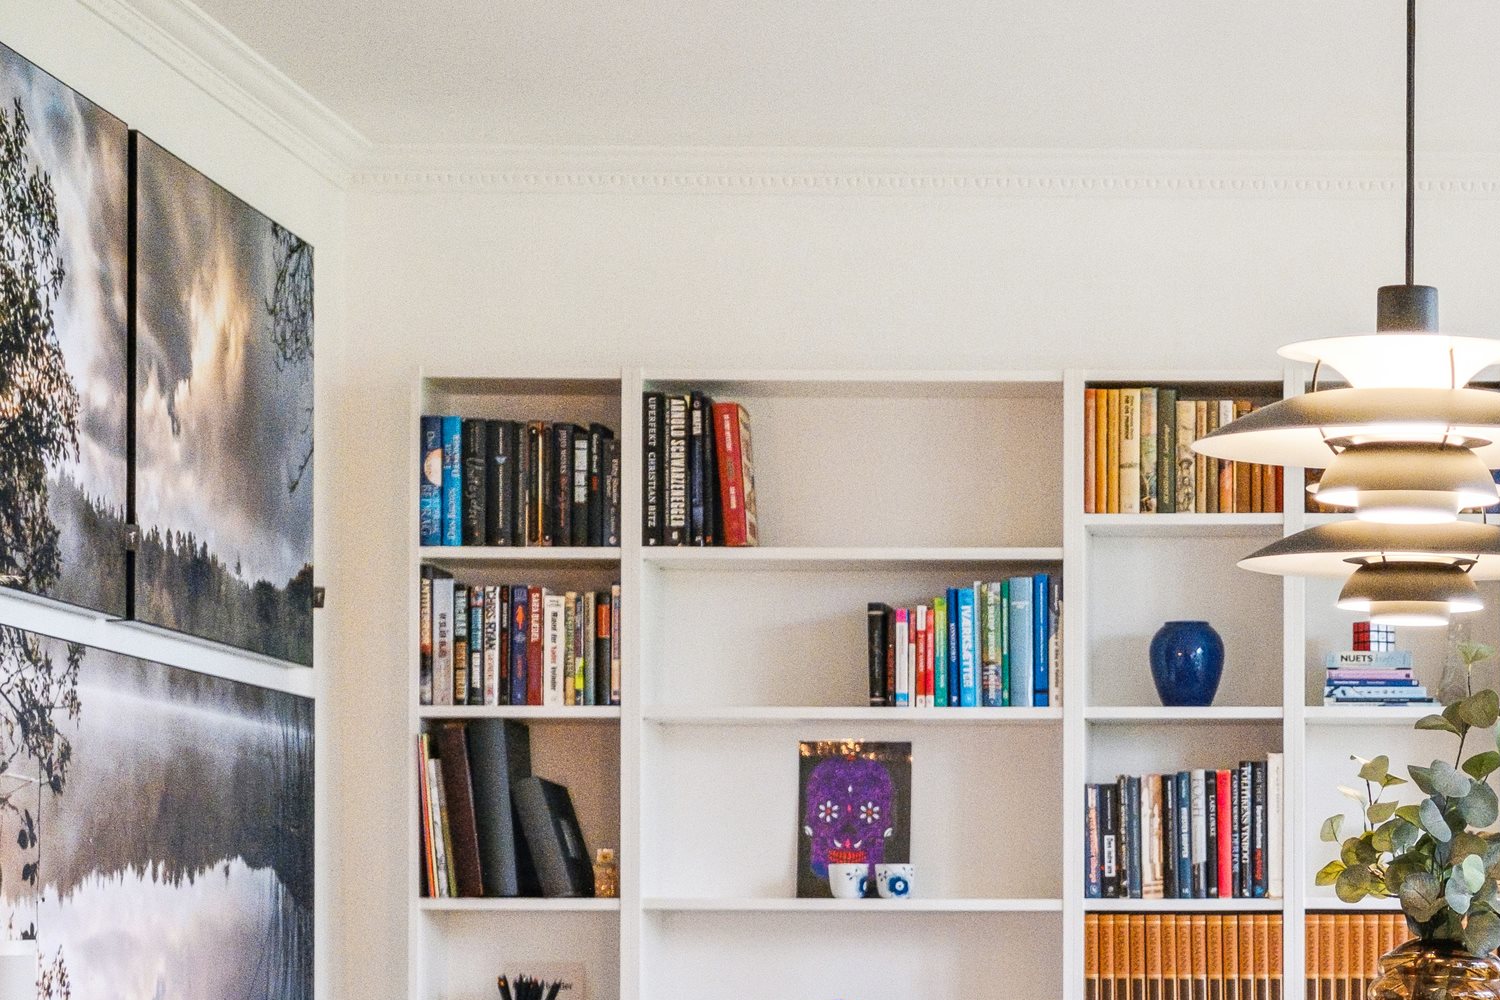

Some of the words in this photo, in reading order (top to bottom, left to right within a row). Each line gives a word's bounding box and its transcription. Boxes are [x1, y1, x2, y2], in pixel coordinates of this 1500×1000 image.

[648, 397, 656, 446] UPERFEKT
[671, 399, 685, 438] ARNOLD
[648, 452, 656, 503] CHRISTIAN
[671, 440, 685, 527] SCHWARZENEGGER
[648, 506, 656, 527] BITZ
[961, 605, 973, 687] IVÆRKSÆTTER
[1240, 766, 1249, 824] POLITIKENS
[1241, 825, 1249, 863] VINBOG
